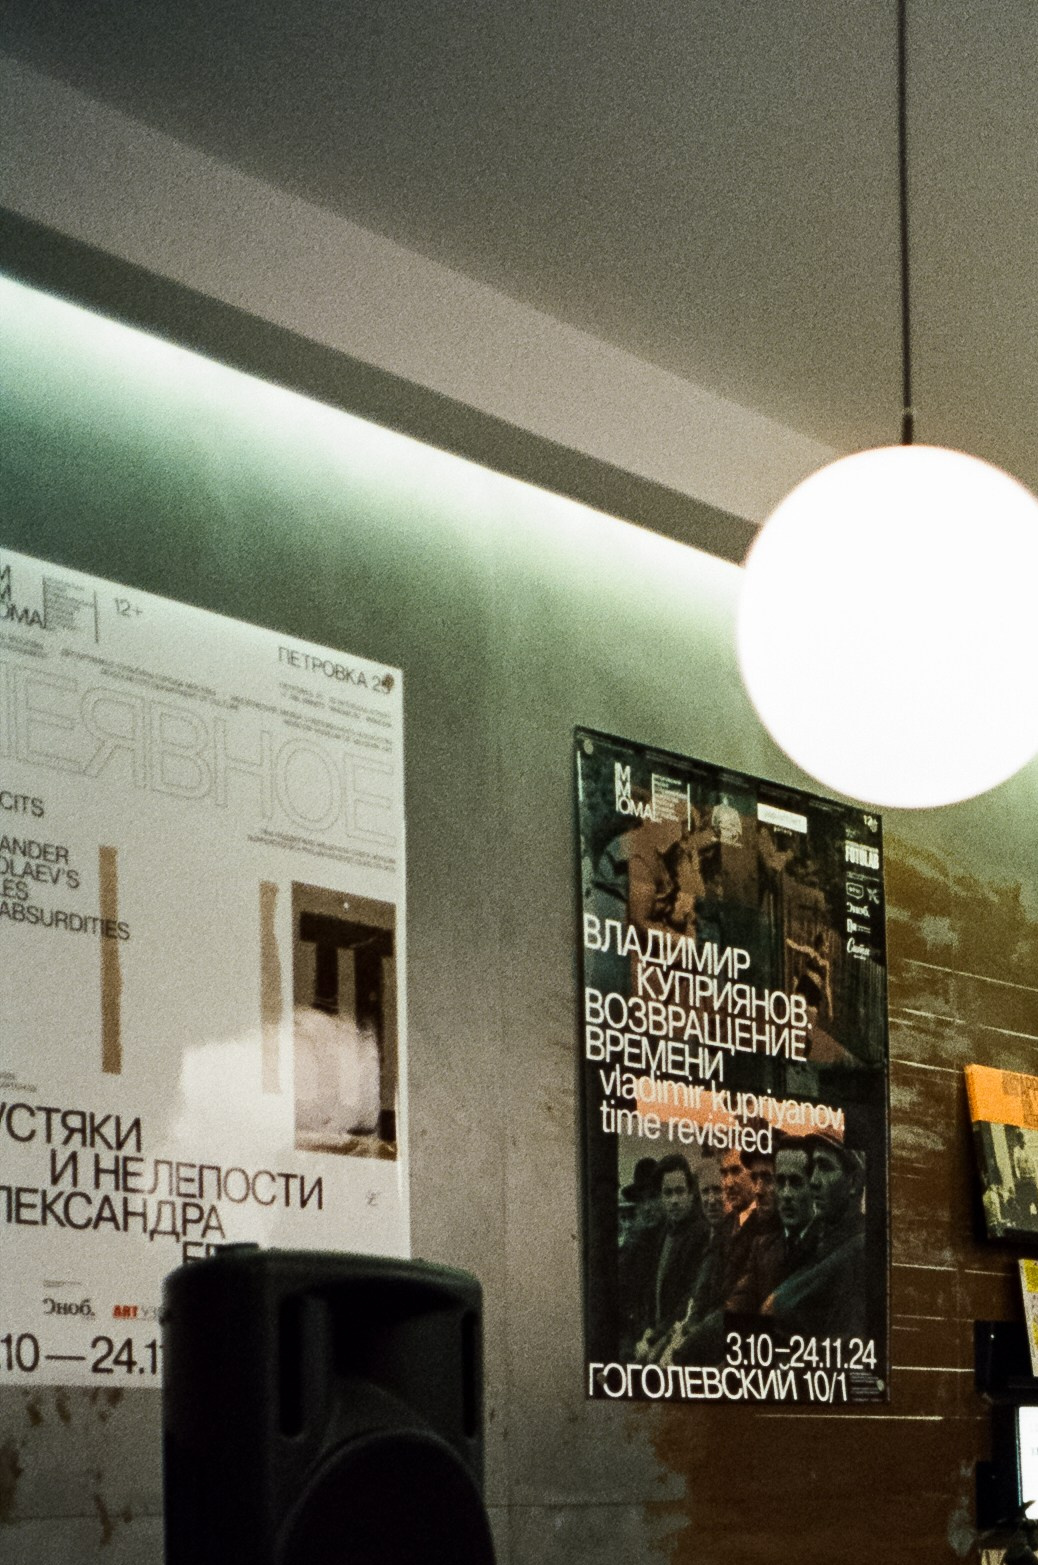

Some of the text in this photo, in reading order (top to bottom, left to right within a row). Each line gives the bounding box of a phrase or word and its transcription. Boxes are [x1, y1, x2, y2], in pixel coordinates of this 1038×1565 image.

[114, 597, 143, 618] 12+
[278, 646, 368, 689] ПЕТРОВКА
[0, 658, 397, 848] ЕЯВНОЕ
[0, 878, 29, 901] ES
[0, 900, 131, 941] ABSURDITIES
[583, 913, 750, 980] ВЛАДИМИР
[637, 962, 813, 1030] КУПРИЯНОВ.
[585, 988, 808, 1063] ВОЗВРАЩЕНИЕ
[585, 1025, 724, 1083] ВРЕМЕНИ
[600, 1063, 845, 1132] vladimir kupriyanov.
[0, 1102, 142, 1153] СТЯКИ
[600, 1099, 773, 1155] time revisited
[50, 1149, 324, 1210] И НЕЛЕПОСТИ
[0, 1332, 164, 1375] 10—24.1
[589, 1361, 798, 1401] ГОГОЛЕВСКИЙ
[802, 1370, 848, 1404] 10/1
